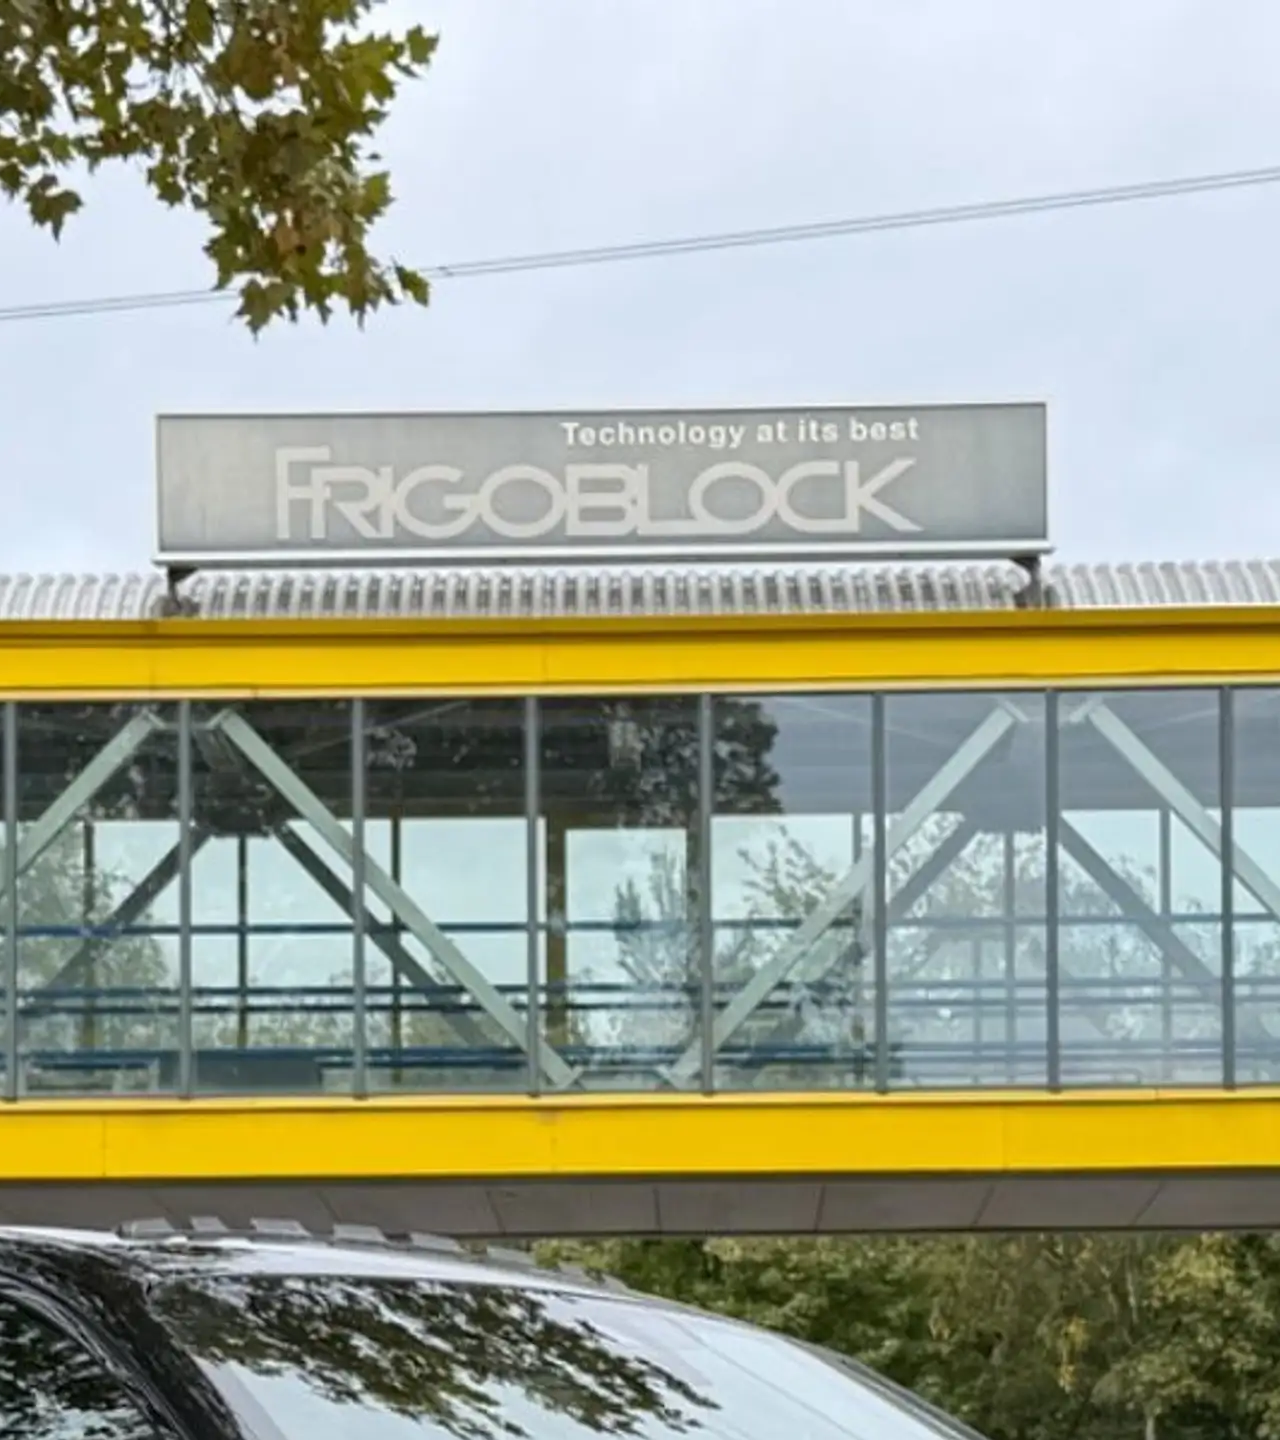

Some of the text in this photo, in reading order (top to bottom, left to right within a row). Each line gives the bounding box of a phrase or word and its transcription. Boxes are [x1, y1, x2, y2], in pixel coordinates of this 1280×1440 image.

[561, 416, 919, 448] Technology at its best
[275, 447, 923, 539] FRIGOBLOCK
